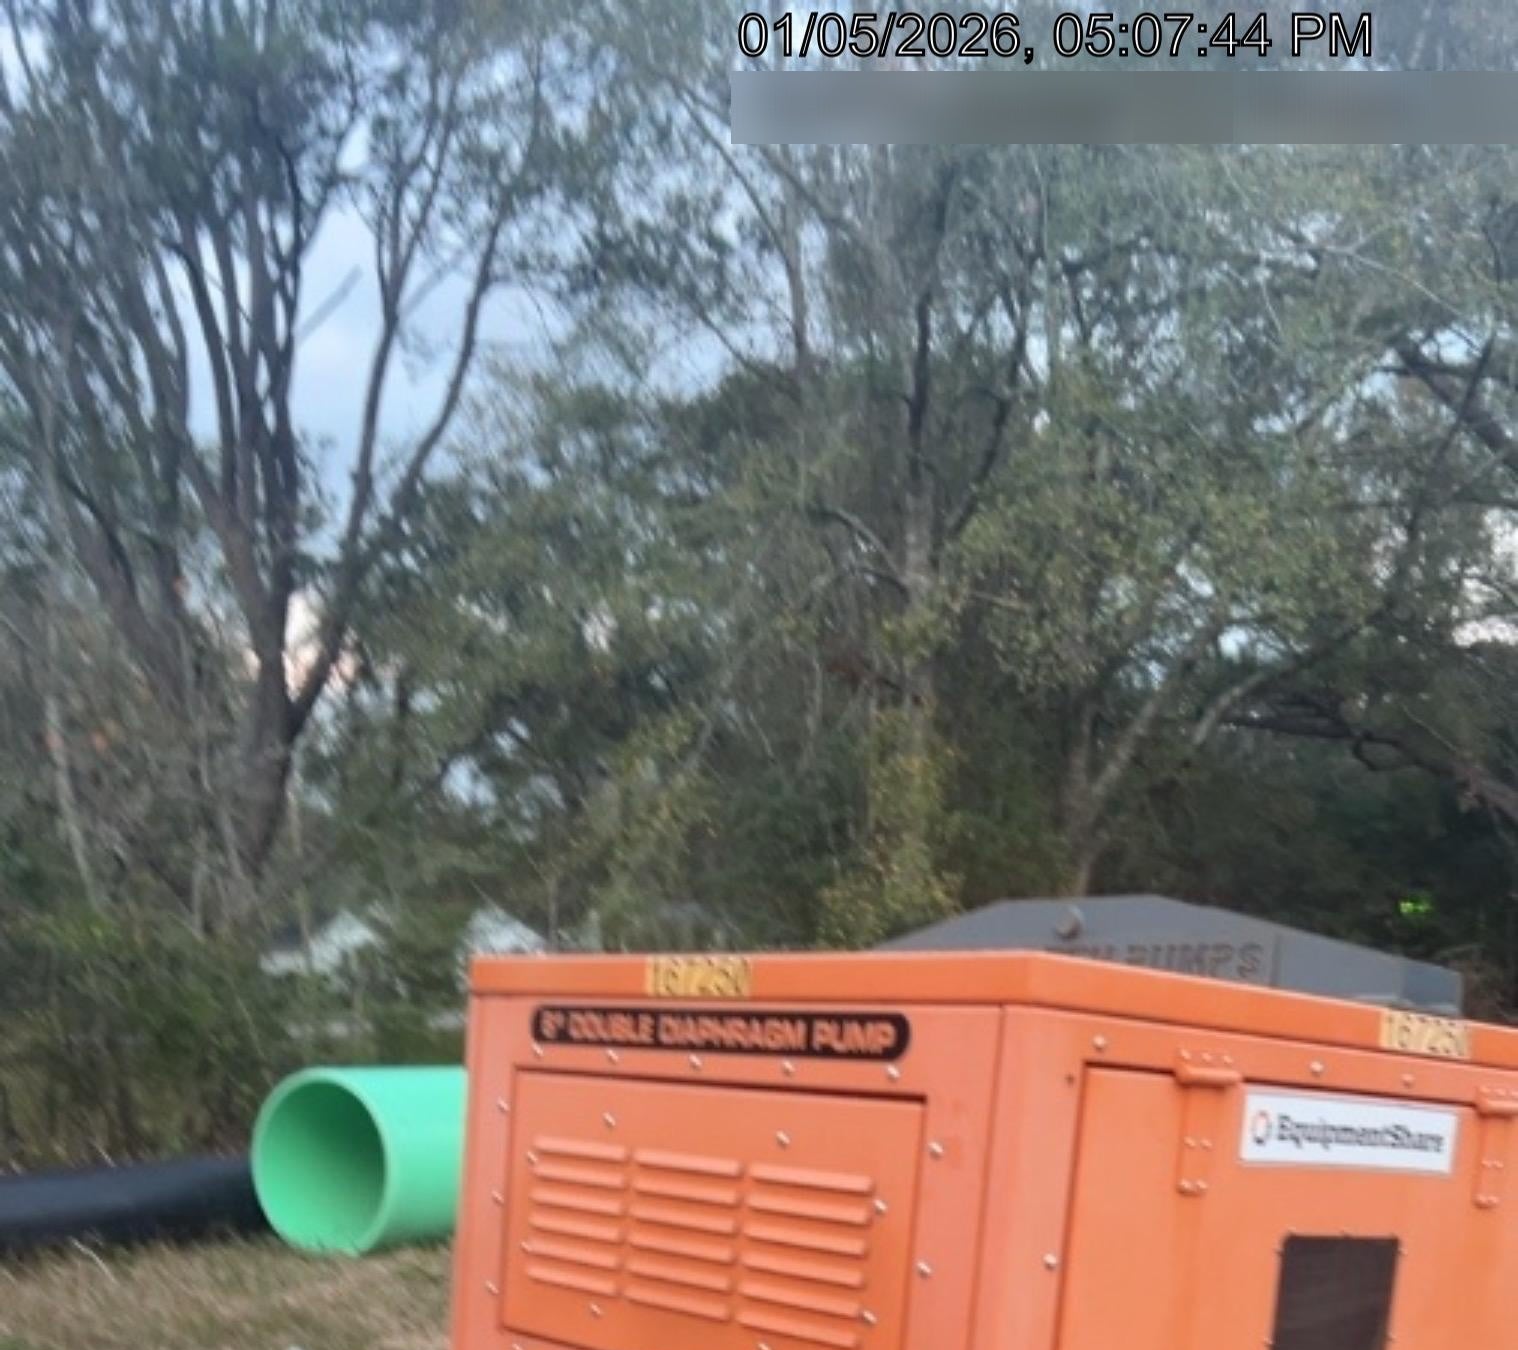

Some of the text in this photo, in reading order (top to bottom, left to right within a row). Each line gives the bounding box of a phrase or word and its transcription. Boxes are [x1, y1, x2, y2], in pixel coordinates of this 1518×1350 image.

[567, 1011, 656, 1044] DOUBLE
[657, 1014, 808, 1052] DIAPHRAGM
[811, 1017, 898, 1055] PUMP
[1276, 1113, 1446, 1153] EquipmentShare
